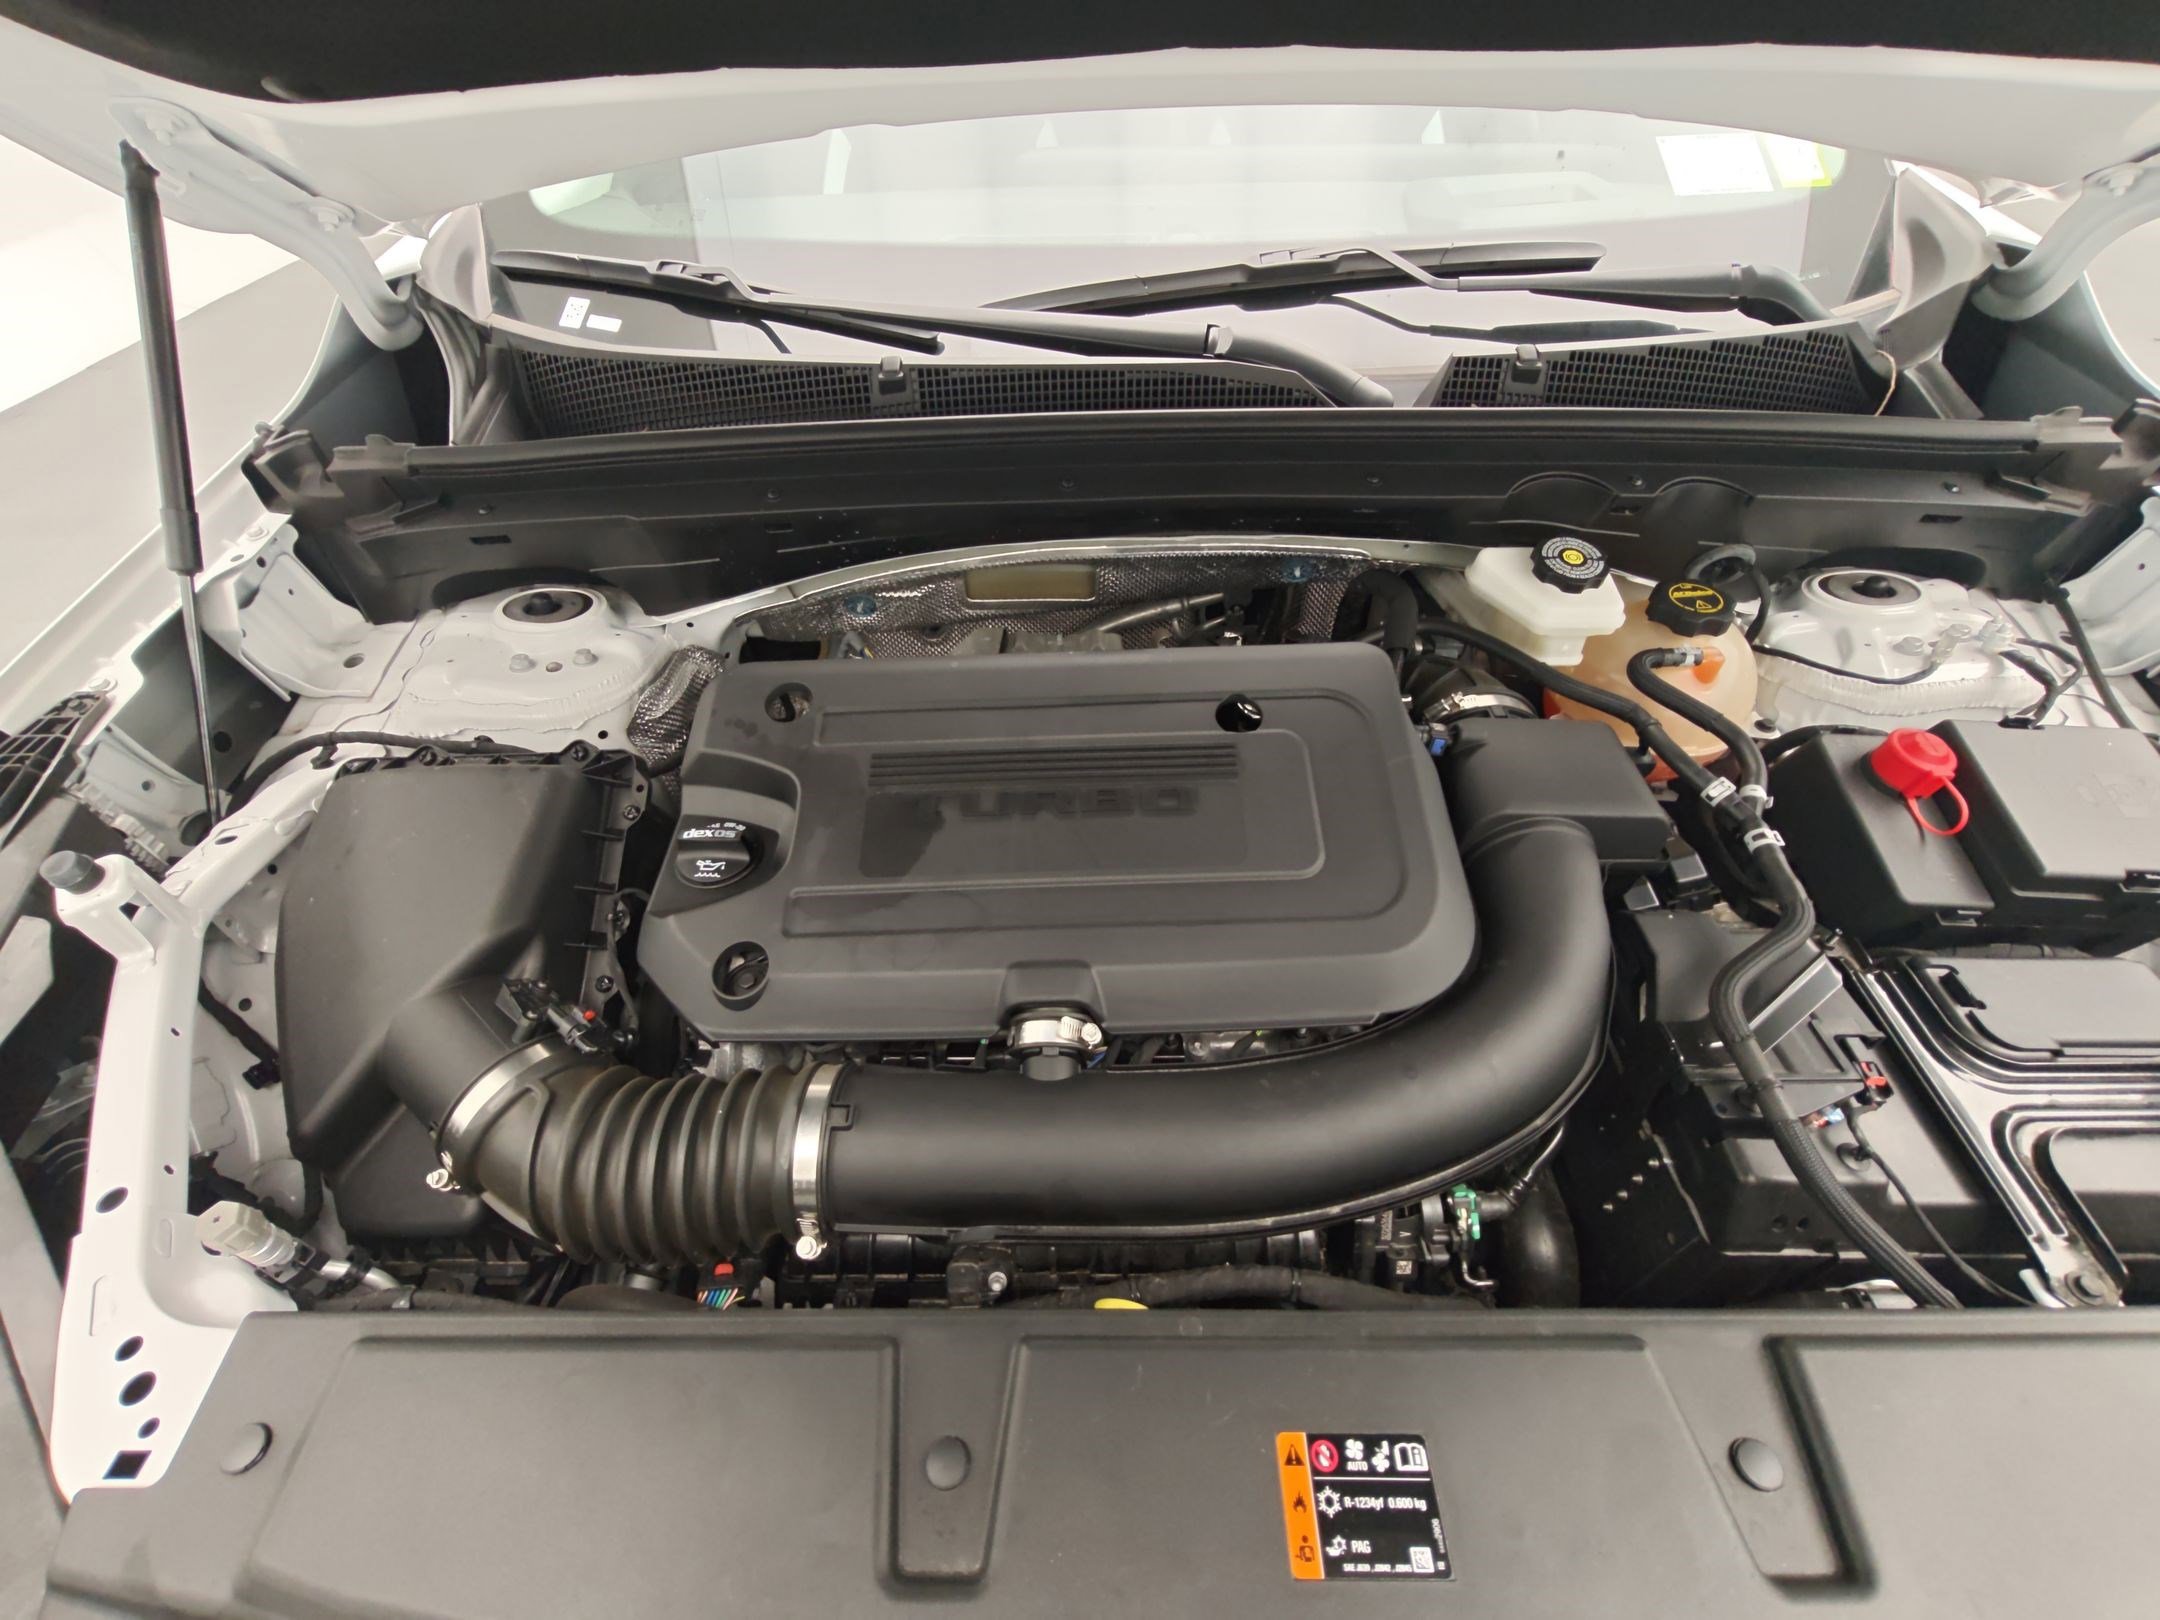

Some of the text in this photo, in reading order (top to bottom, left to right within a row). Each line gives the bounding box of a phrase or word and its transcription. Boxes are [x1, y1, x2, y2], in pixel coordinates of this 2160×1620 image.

[682, 828, 737, 839] dexos
[1347, 1461, 1369, 1471] AUTO
[1414, 1497, 1427, 1511] kg
[1350, 1540, 1372, 1554] PAG
